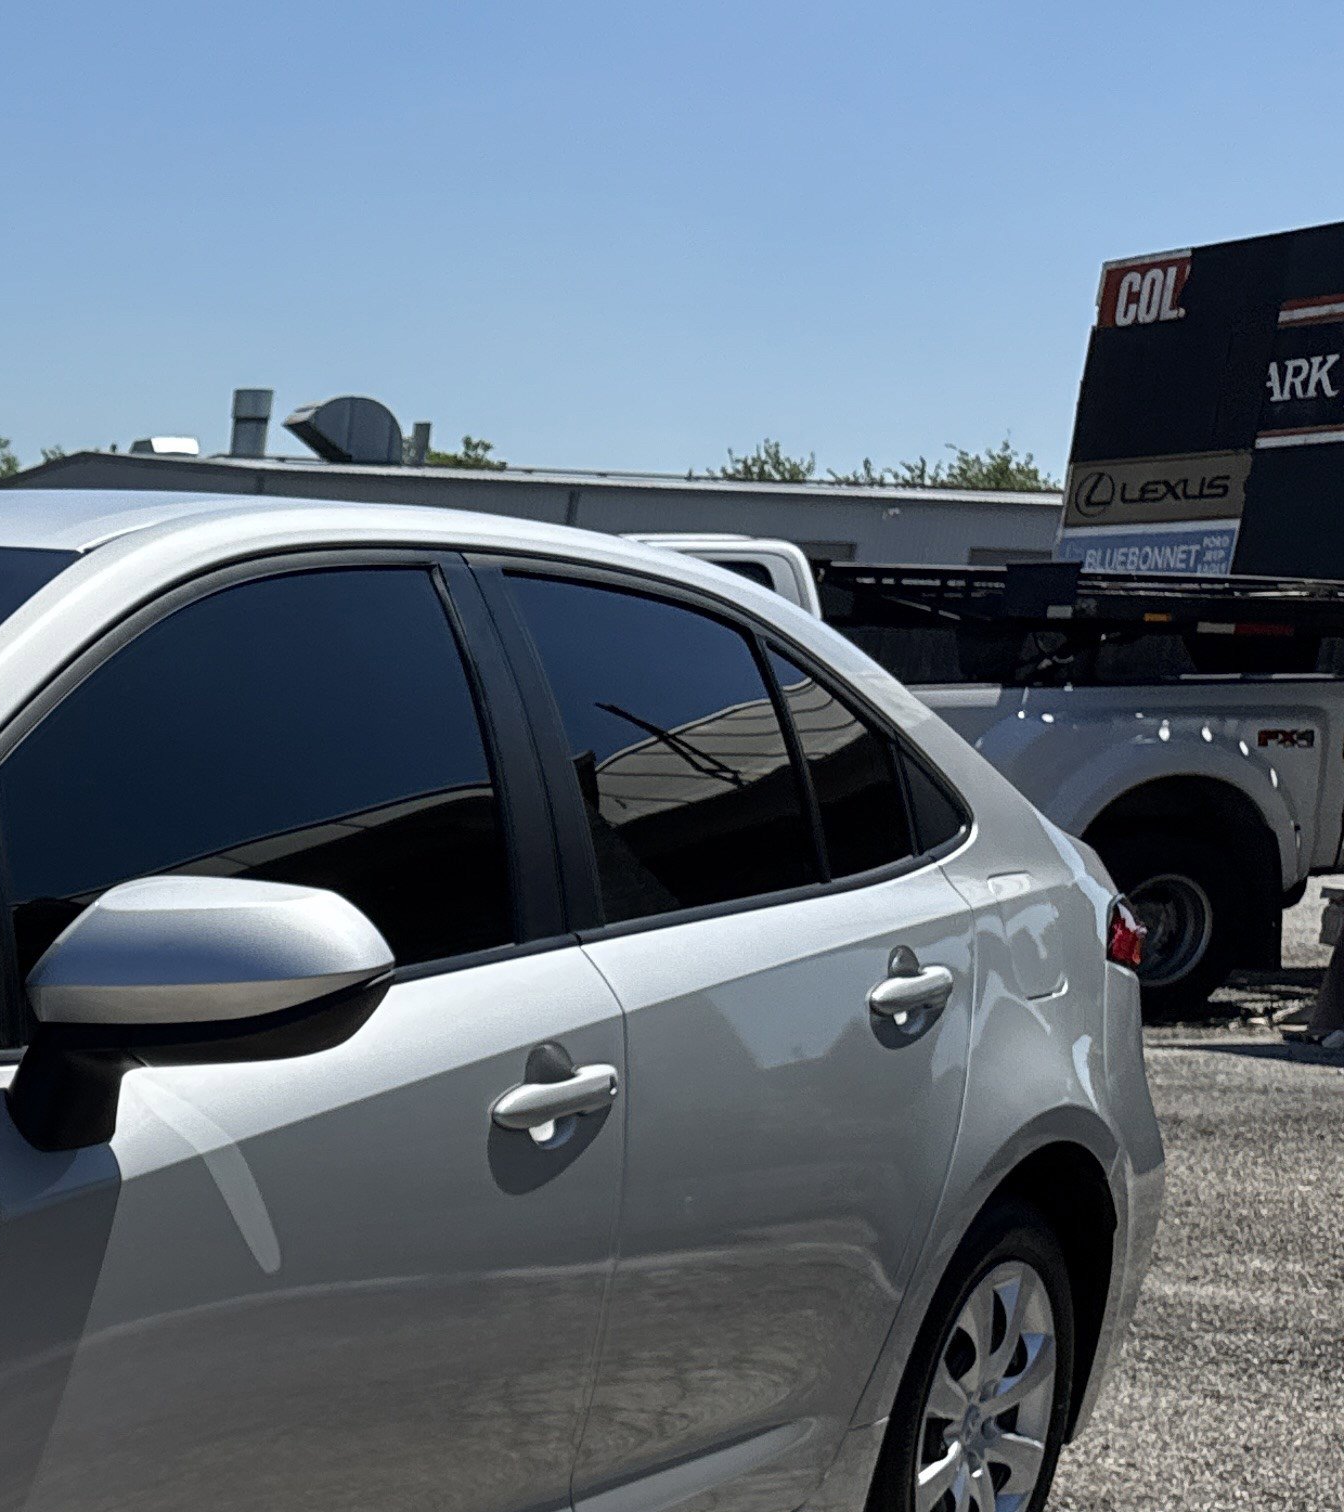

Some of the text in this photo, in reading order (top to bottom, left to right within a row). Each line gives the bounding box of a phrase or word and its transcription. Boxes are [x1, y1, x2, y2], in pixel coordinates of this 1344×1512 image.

[1114, 264, 1192, 327] COL
[1120, 474, 1231, 504] LEXUS
[1084, 544, 1200, 571] BLUEBONNET
